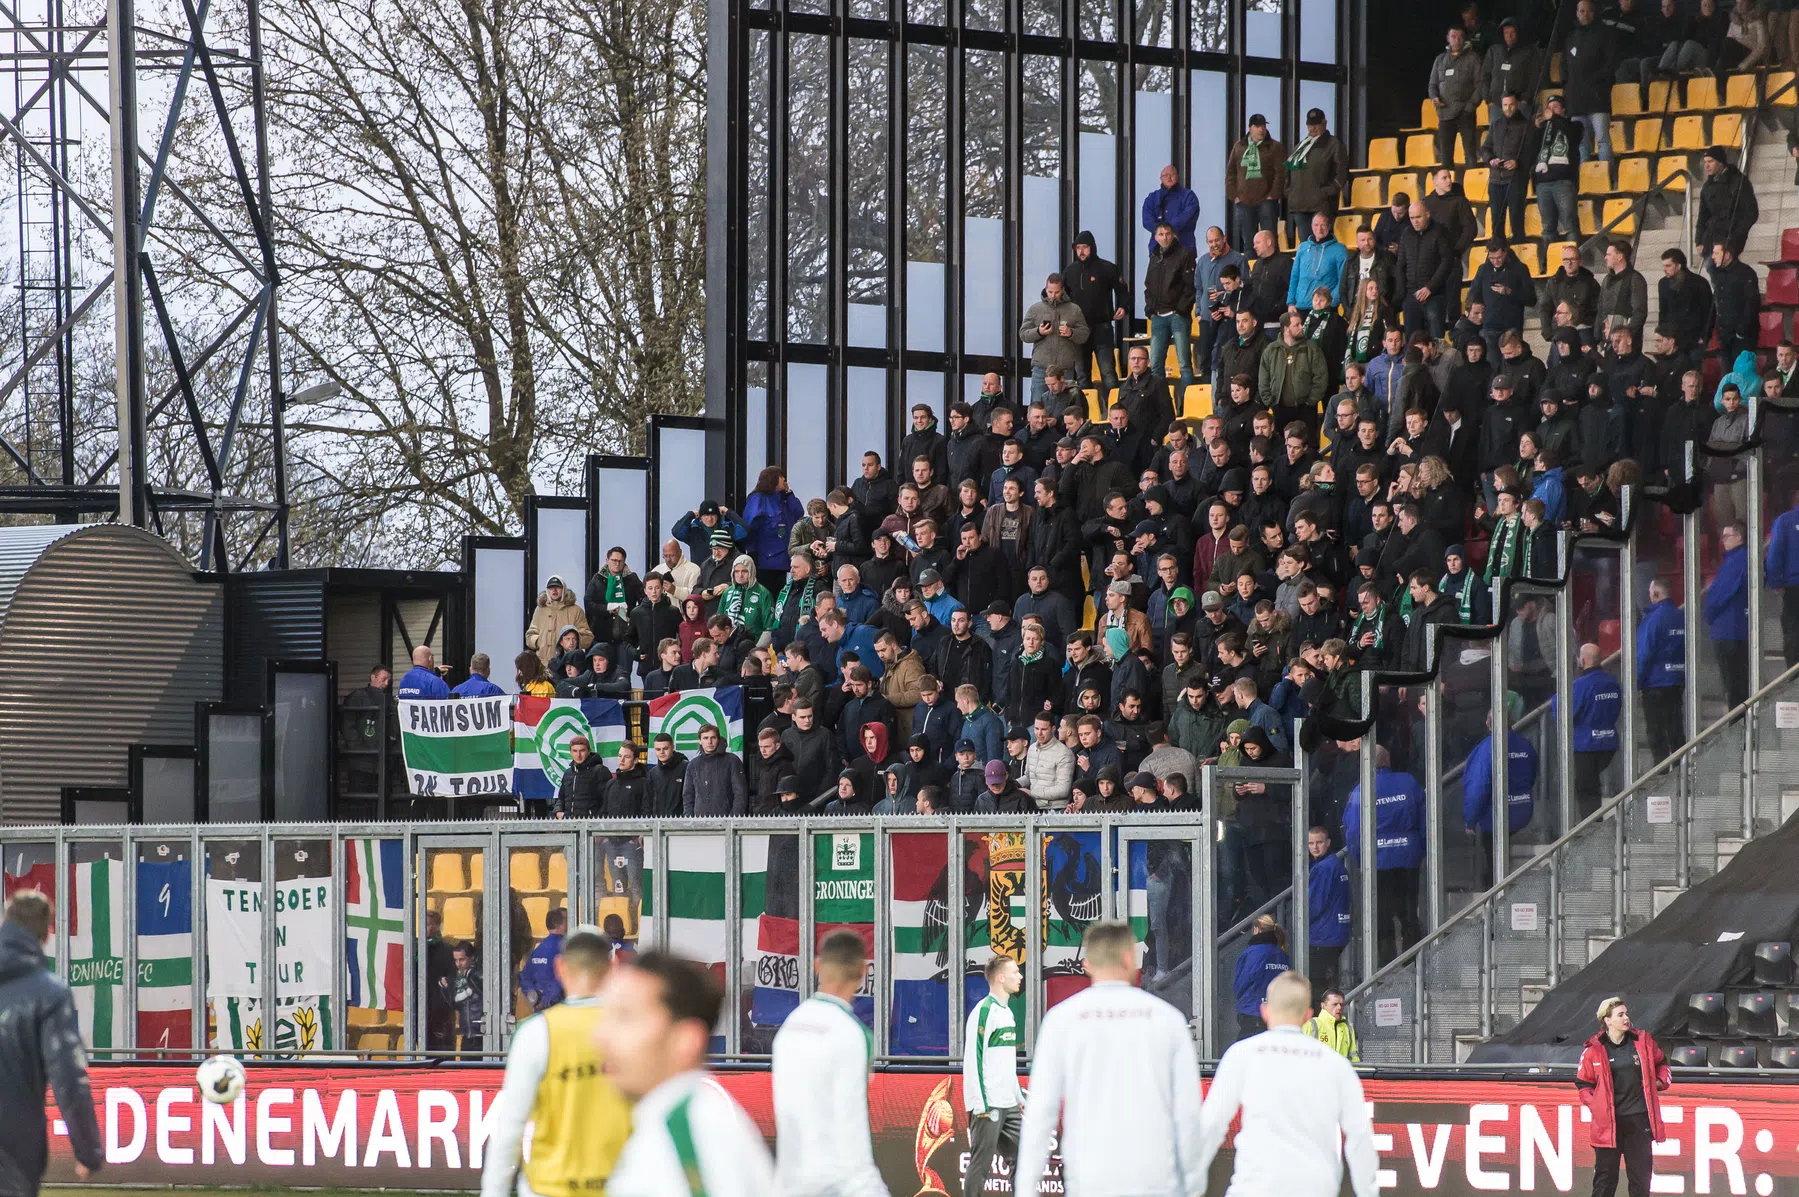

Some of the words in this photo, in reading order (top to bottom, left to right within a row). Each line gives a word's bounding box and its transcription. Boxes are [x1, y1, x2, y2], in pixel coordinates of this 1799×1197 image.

[409, 700, 502, 733] FARMSUM
[449, 773, 510, 796] TOUR
[222, 888, 262, 913] TEN
[275, 885, 327, 913] BOER
[815, 879, 874, 900] GRONINGE
[137, 963, 153, 983] FC
[245, 960, 304, 984] TUR
[105, 1087, 507, 1169] DENEMARK
[1364, 1101, 1775, 1196] EVENER:
